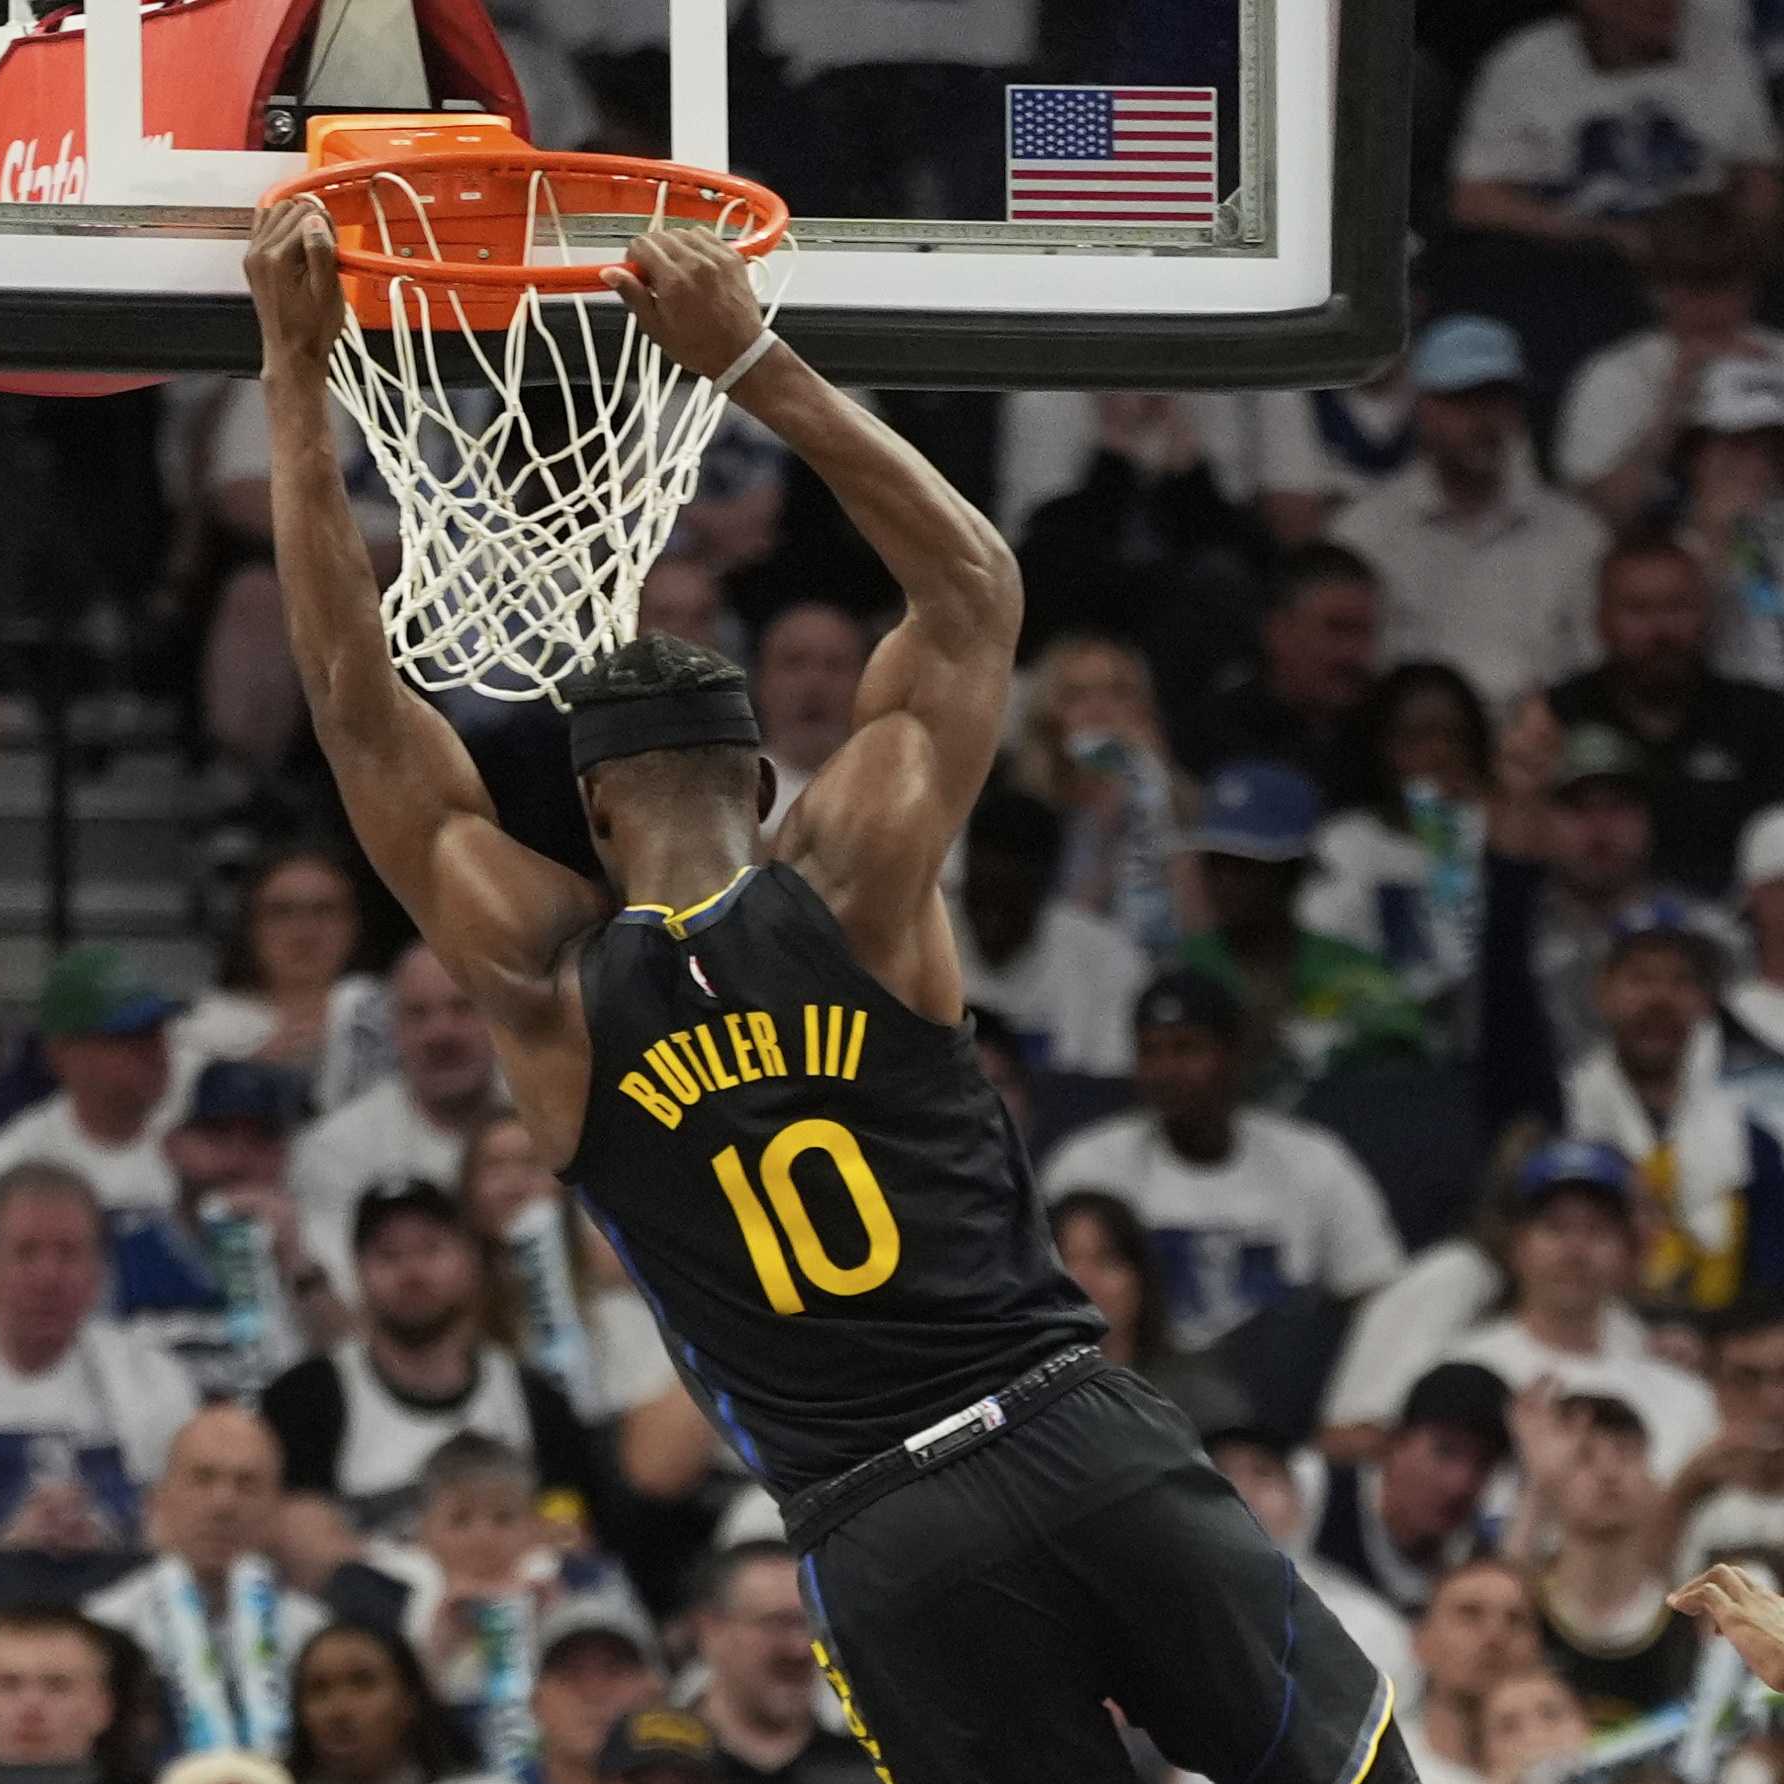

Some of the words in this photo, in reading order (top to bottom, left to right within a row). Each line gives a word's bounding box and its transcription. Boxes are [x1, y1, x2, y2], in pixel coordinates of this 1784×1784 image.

[618, 1010, 787, 1131] BUTLER
[804, 1003, 868, 1082] III
[711, 1118, 902, 1316] 10
